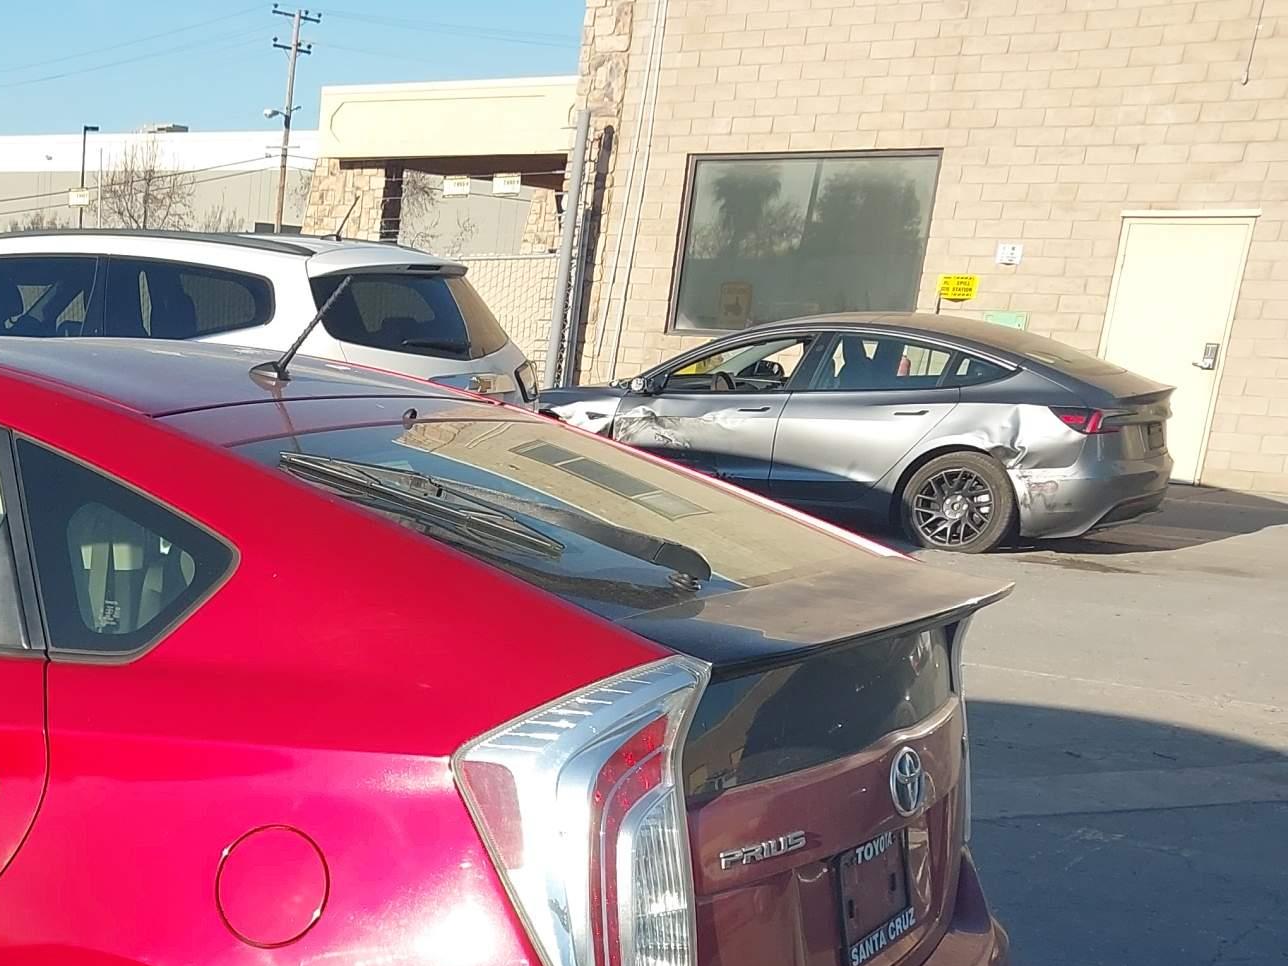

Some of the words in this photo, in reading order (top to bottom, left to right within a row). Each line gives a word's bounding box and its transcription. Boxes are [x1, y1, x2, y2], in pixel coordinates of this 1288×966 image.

[719, 830, 806, 871] PRIUS
[855, 831, 894, 865] TOYOTA
[851, 929, 887, 966] SANTA
[888, 906, 916, 940] CRUZ
